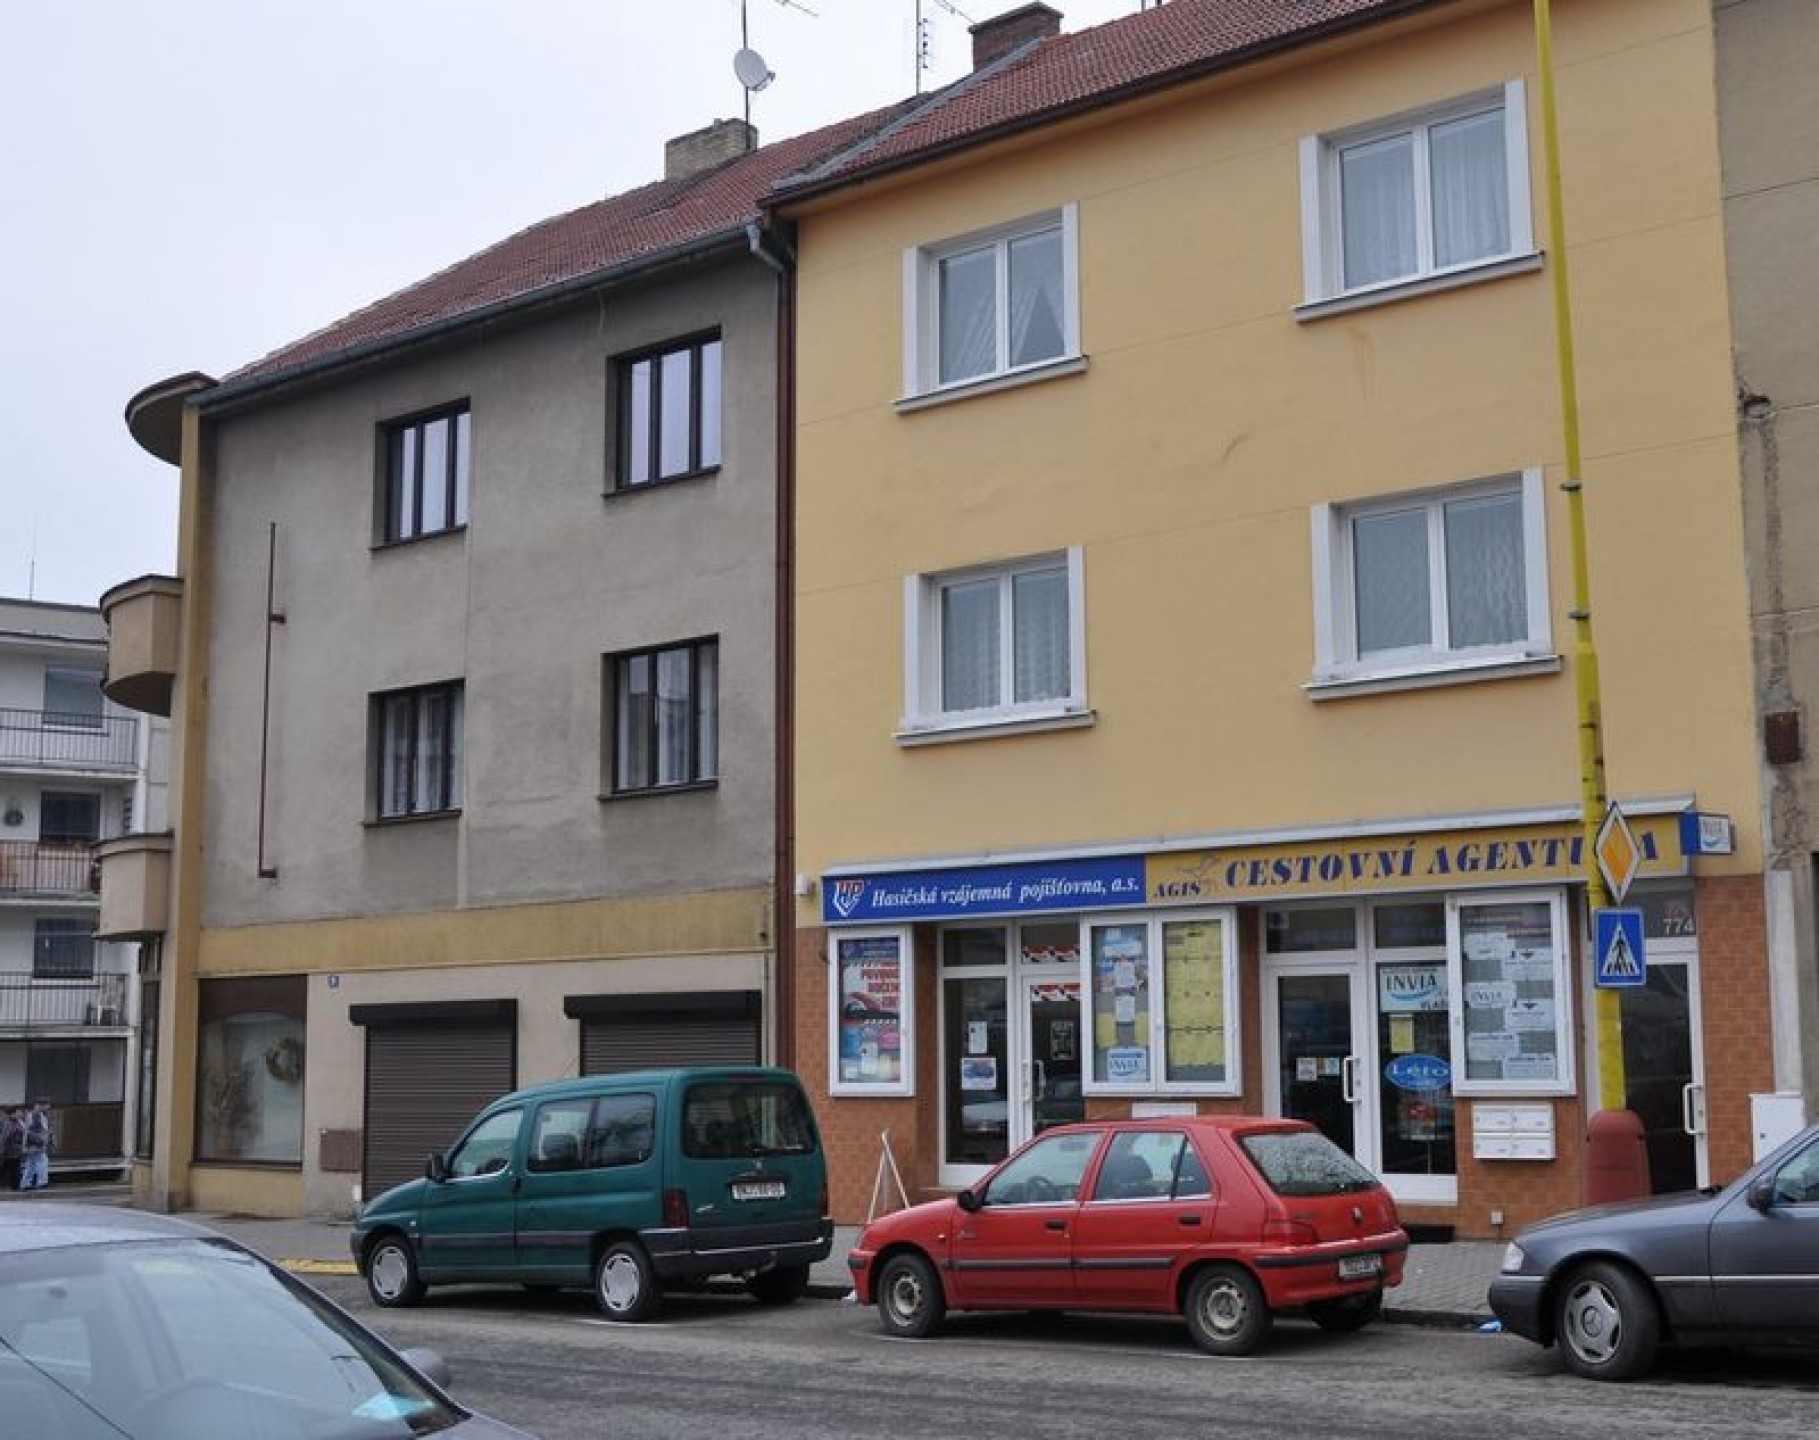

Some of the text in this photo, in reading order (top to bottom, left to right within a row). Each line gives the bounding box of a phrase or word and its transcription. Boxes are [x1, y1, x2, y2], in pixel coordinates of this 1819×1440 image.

[1225, 832, 1658, 887] CESTOVNÍ AGENTA
[872, 886, 938, 908] Hasičská
[941, 879, 1012, 906] vzájemná
[1111, 876, 1140, 893] a.s.
[1152, 879, 1201, 899] AGIS
[1386, 973, 1438, 991] INVIA
